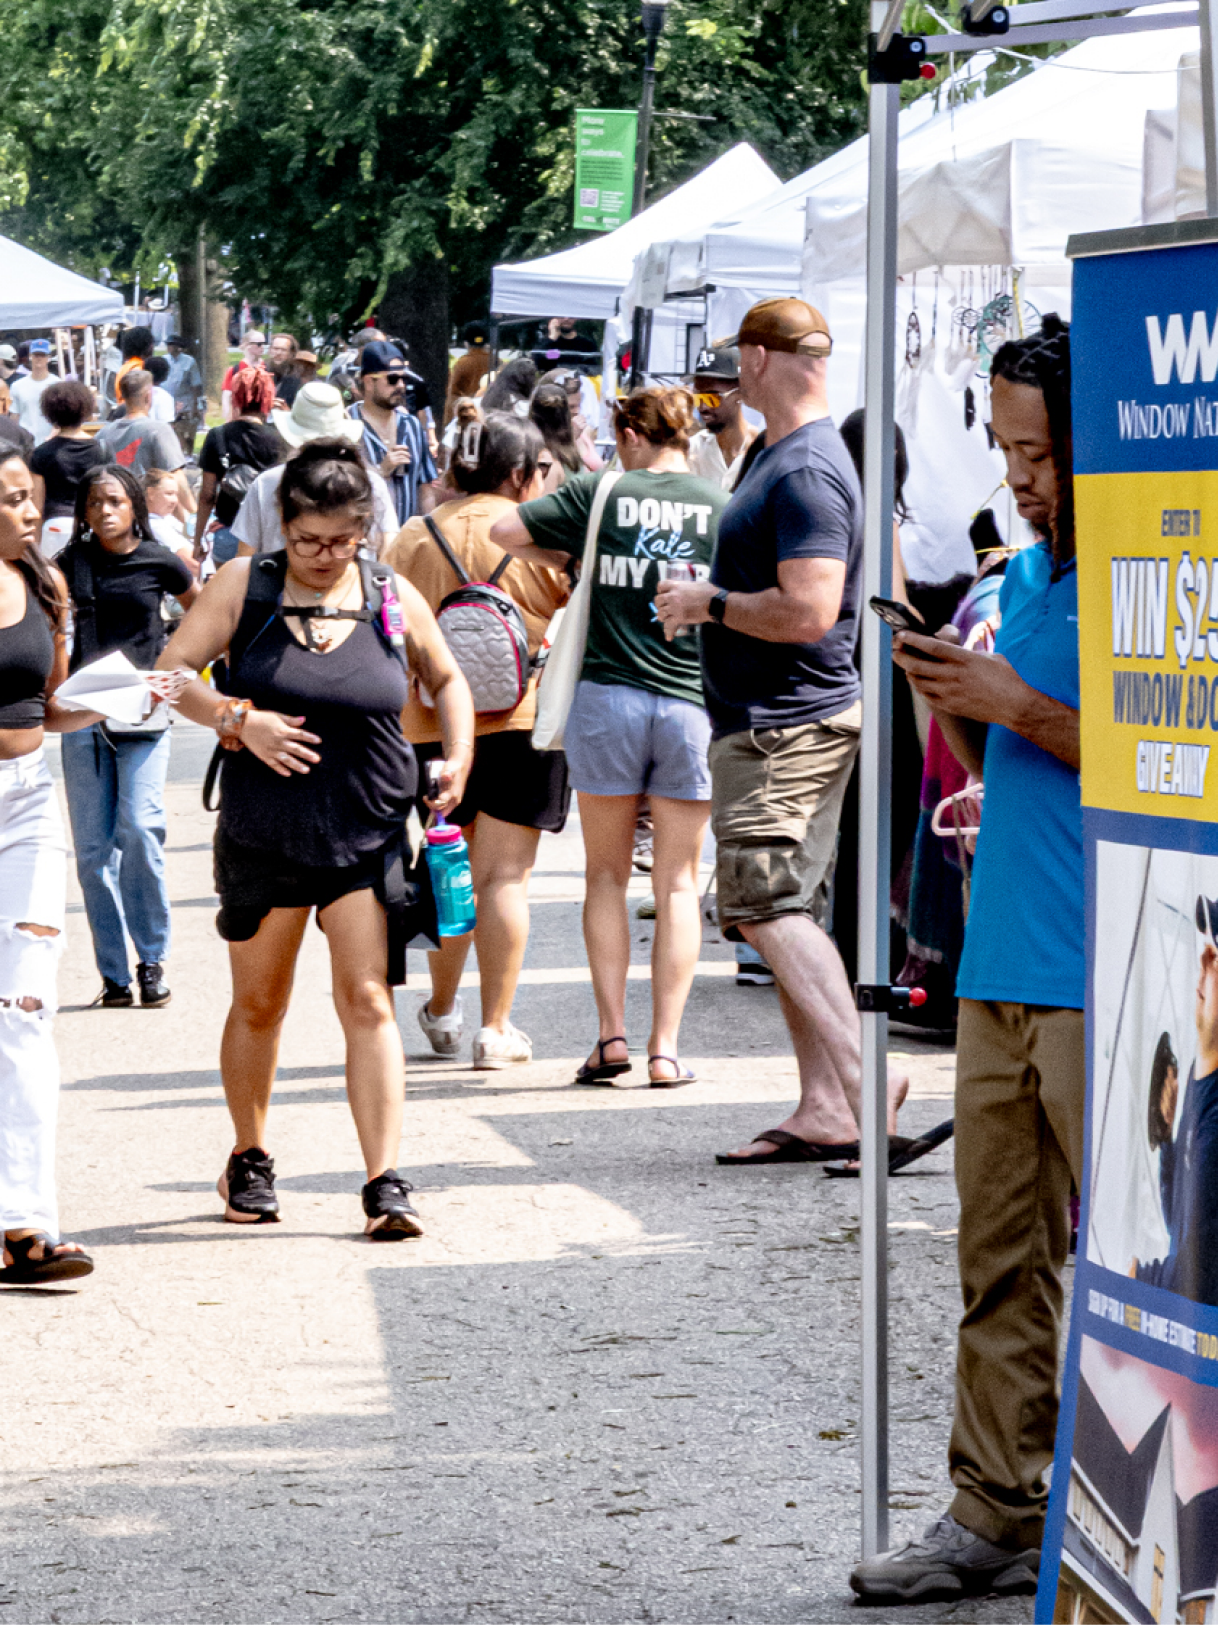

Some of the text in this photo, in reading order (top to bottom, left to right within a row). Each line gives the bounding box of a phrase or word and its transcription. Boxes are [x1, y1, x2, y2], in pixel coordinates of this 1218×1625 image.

[1117, 399, 1190, 440] WINDOW
[616, 496, 713, 535] DON'T
[634, 525, 695, 560] Kale
[599, 554, 650, 588] MY
[1111, 557, 1169, 659] WIN
[1113, 671, 1182, 728] WINDOW
